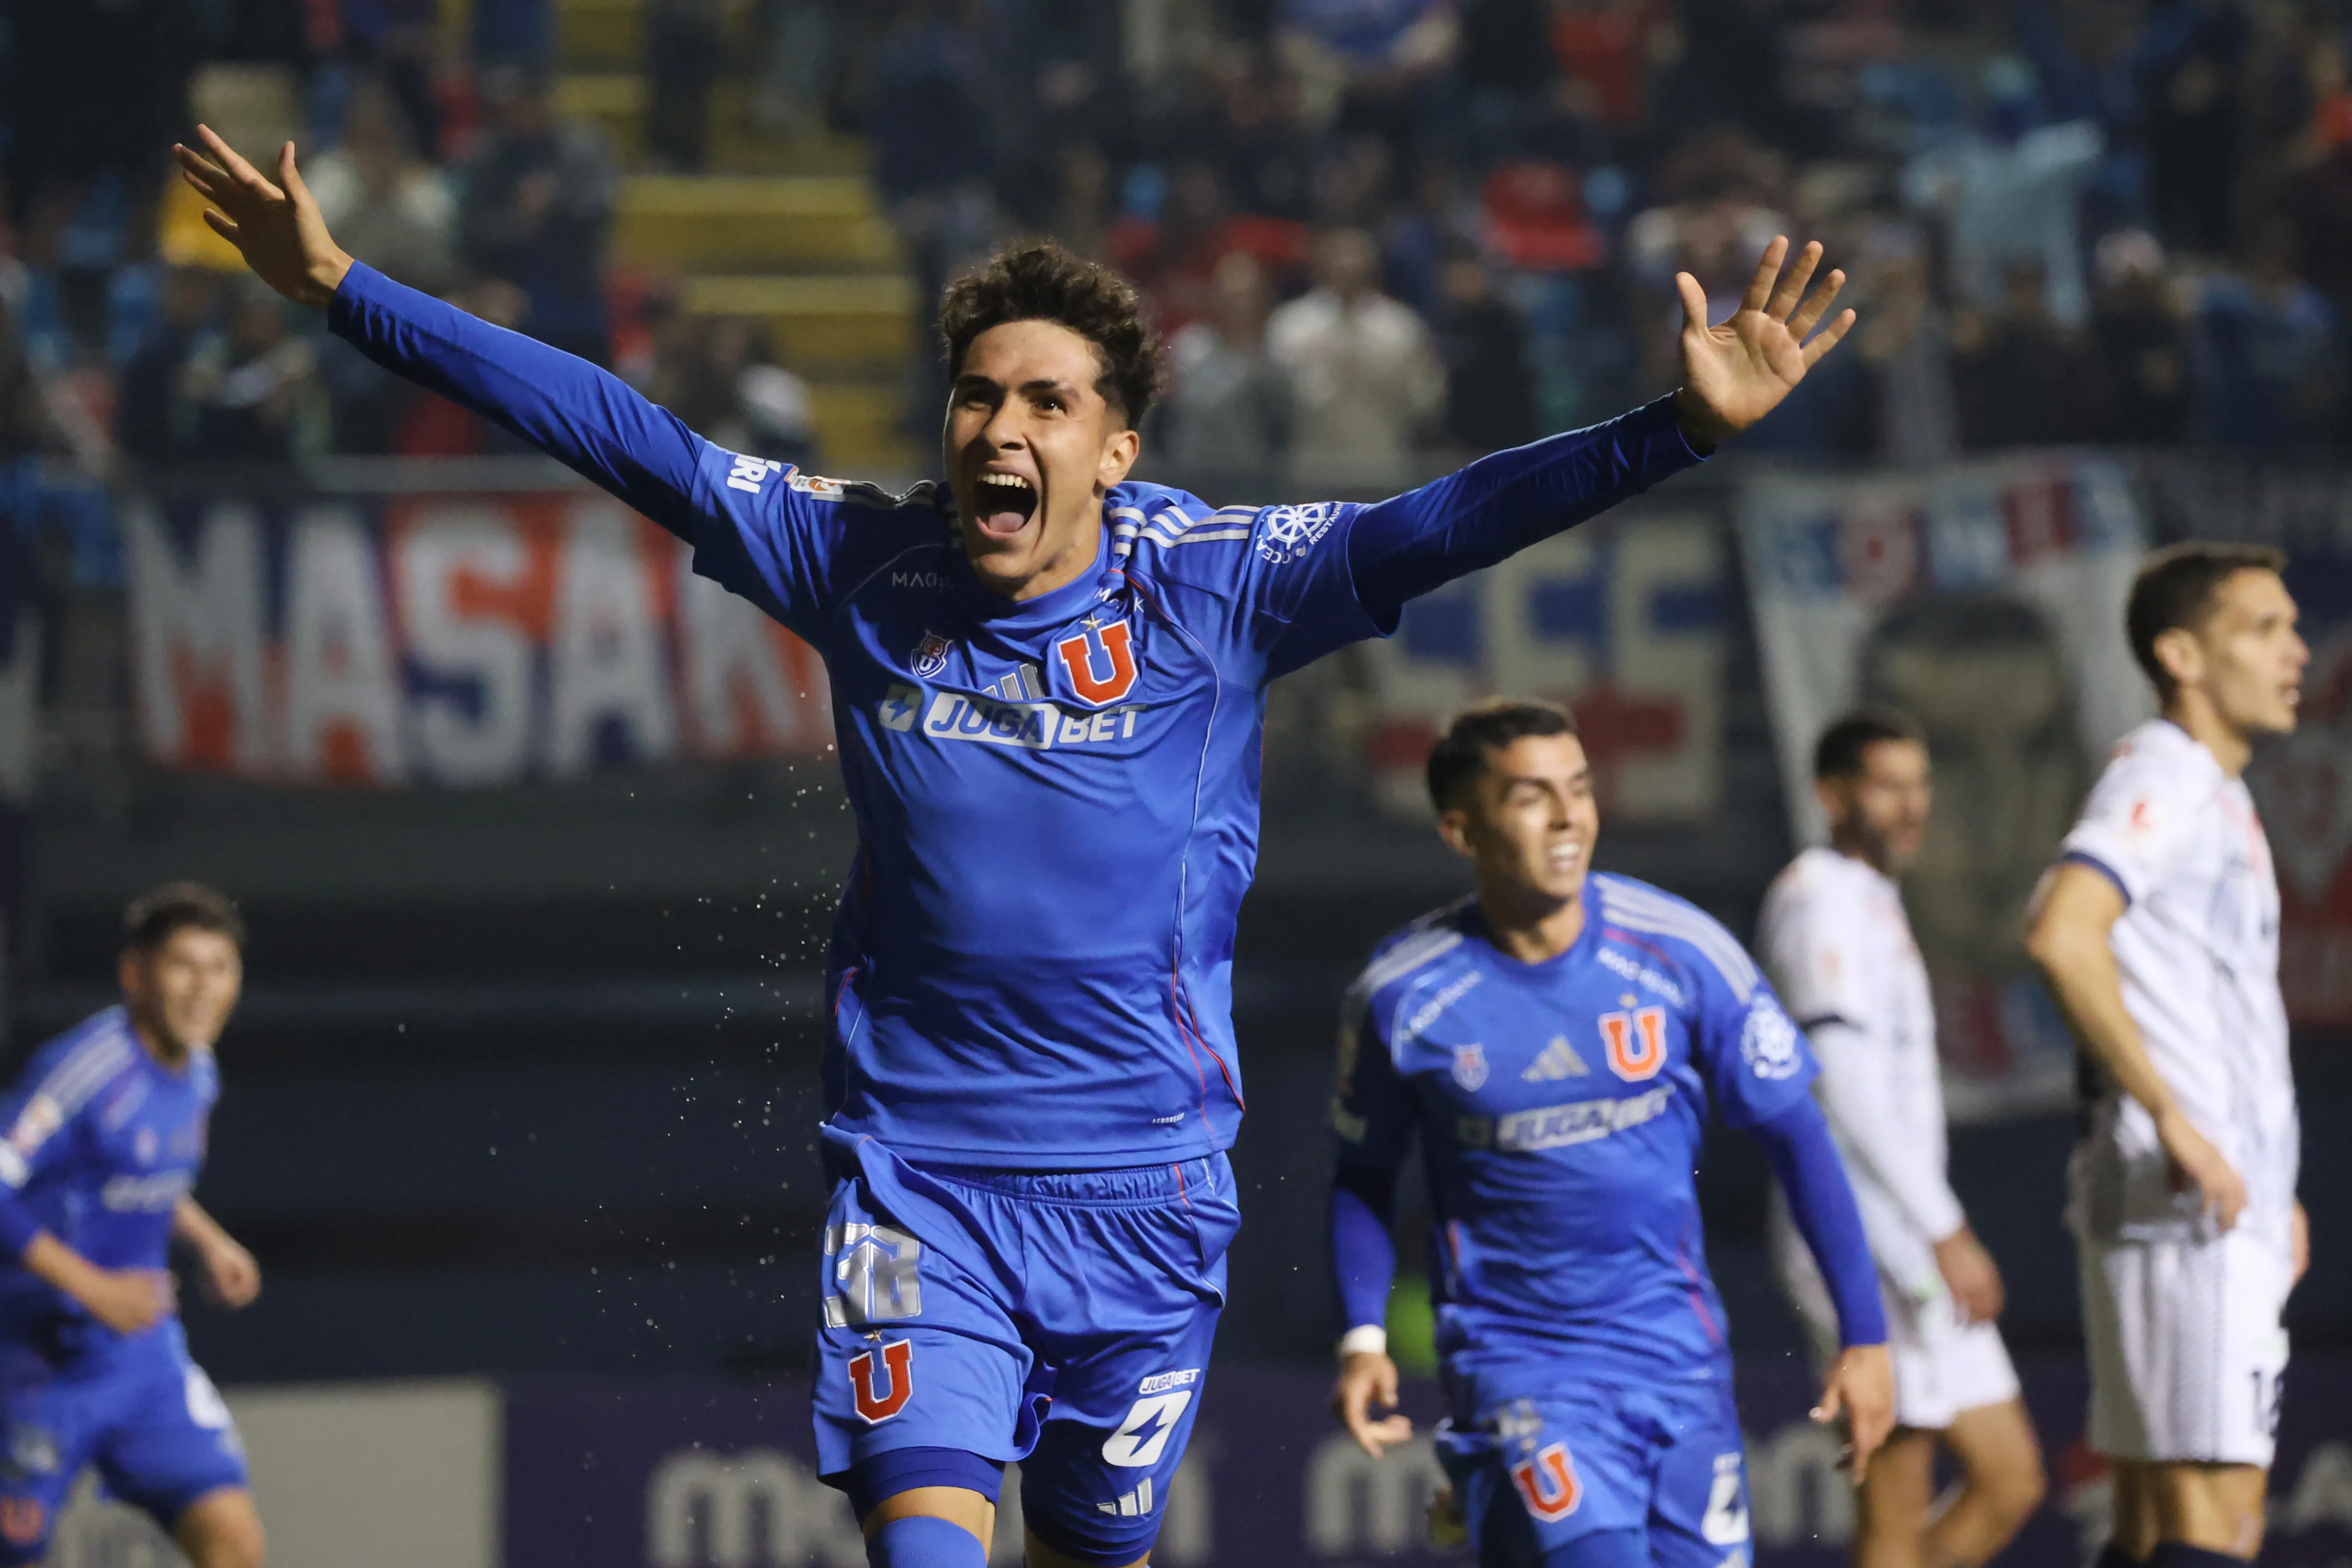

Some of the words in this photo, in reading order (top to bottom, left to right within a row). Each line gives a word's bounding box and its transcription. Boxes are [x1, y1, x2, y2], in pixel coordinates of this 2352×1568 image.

[1058, 619, 1138, 707] U
[1598, 1005, 1666, 1083] U
[848, 1338, 913, 1425] U
[1509, 1441, 1584, 1524] U
